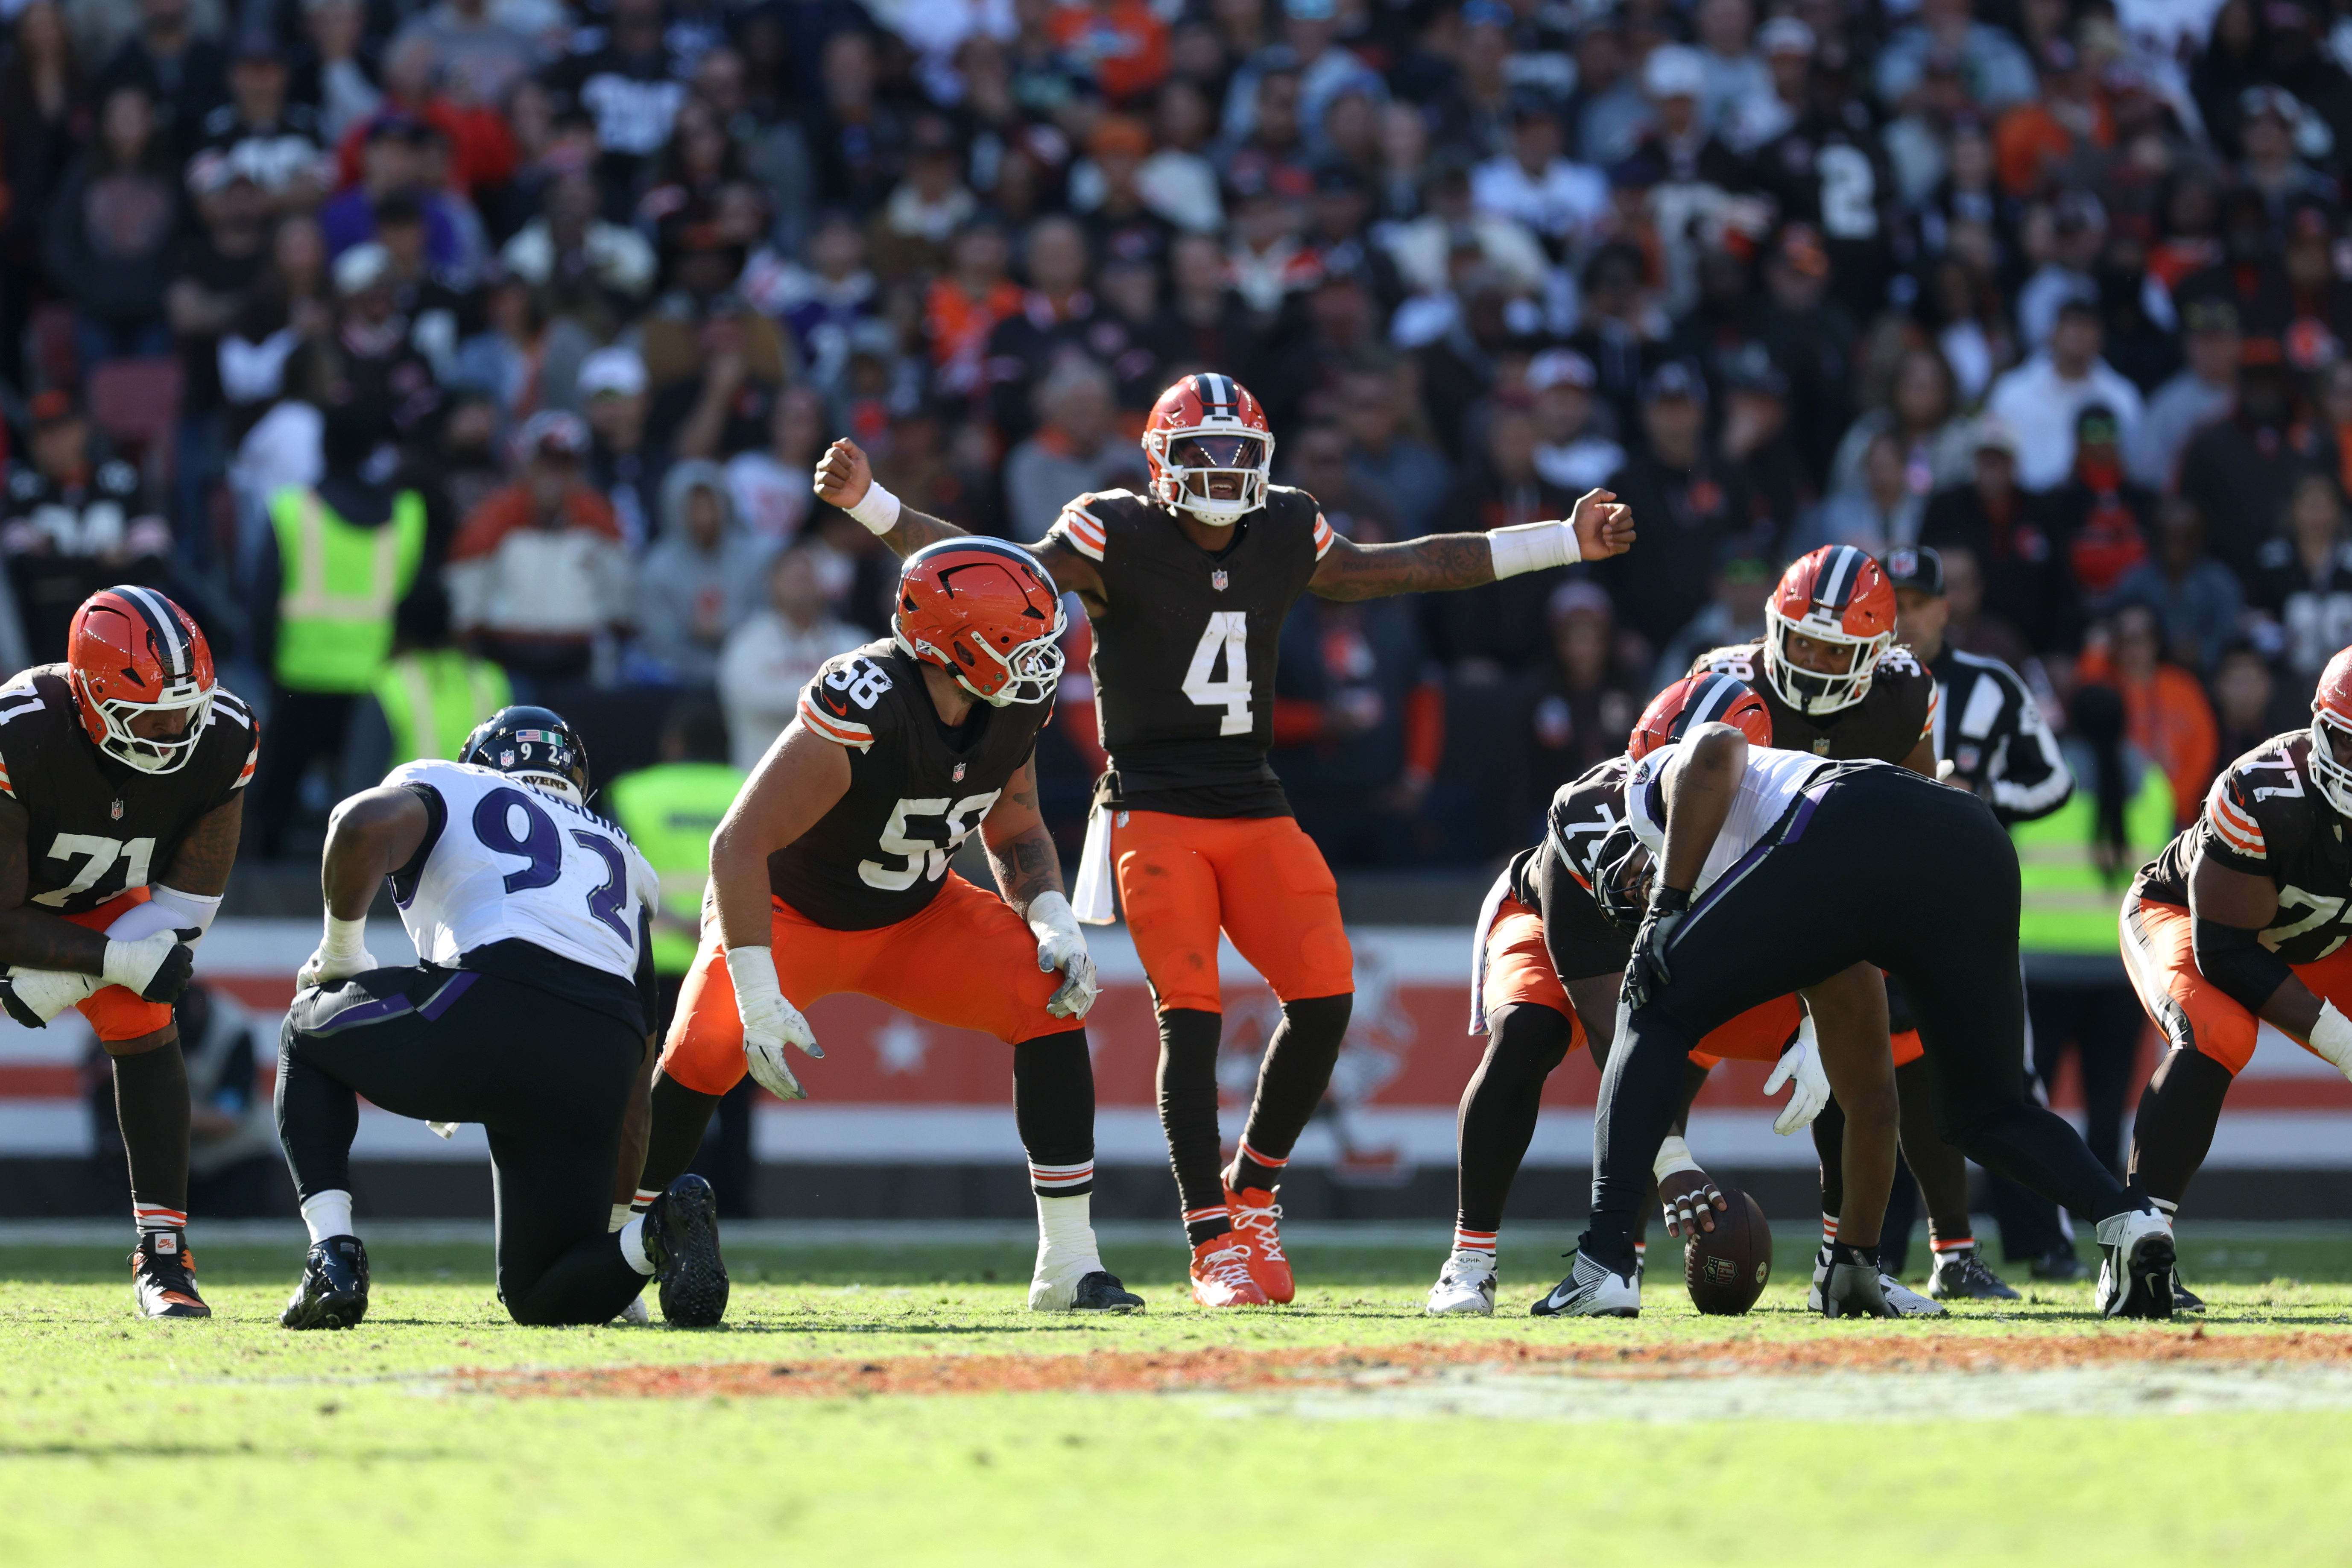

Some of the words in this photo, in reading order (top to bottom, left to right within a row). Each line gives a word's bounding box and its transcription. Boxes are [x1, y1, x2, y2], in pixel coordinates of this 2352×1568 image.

[1816, 146, 1878, 239] 2
[825, 654, 893, 710] 58
[1181, 611, 1253, 736] 4
[173, 687, 192, 697] BROWNS
[521, 743, 532, 760] 9
[548, 745, 559, 764] 2
[521, 776, 568, 791] AVENS
[954, 770, 963, 780] NFL
[2238, 748, 2305, 803] 77
[113, 807, 122, 817] NFL
[30, 833, 156, 907] 71
[473, 787, 634, 949] 92
[1717, 1262, 1735, 1284] NFL
[1571, 1292, 1597, 1311] FORCE
